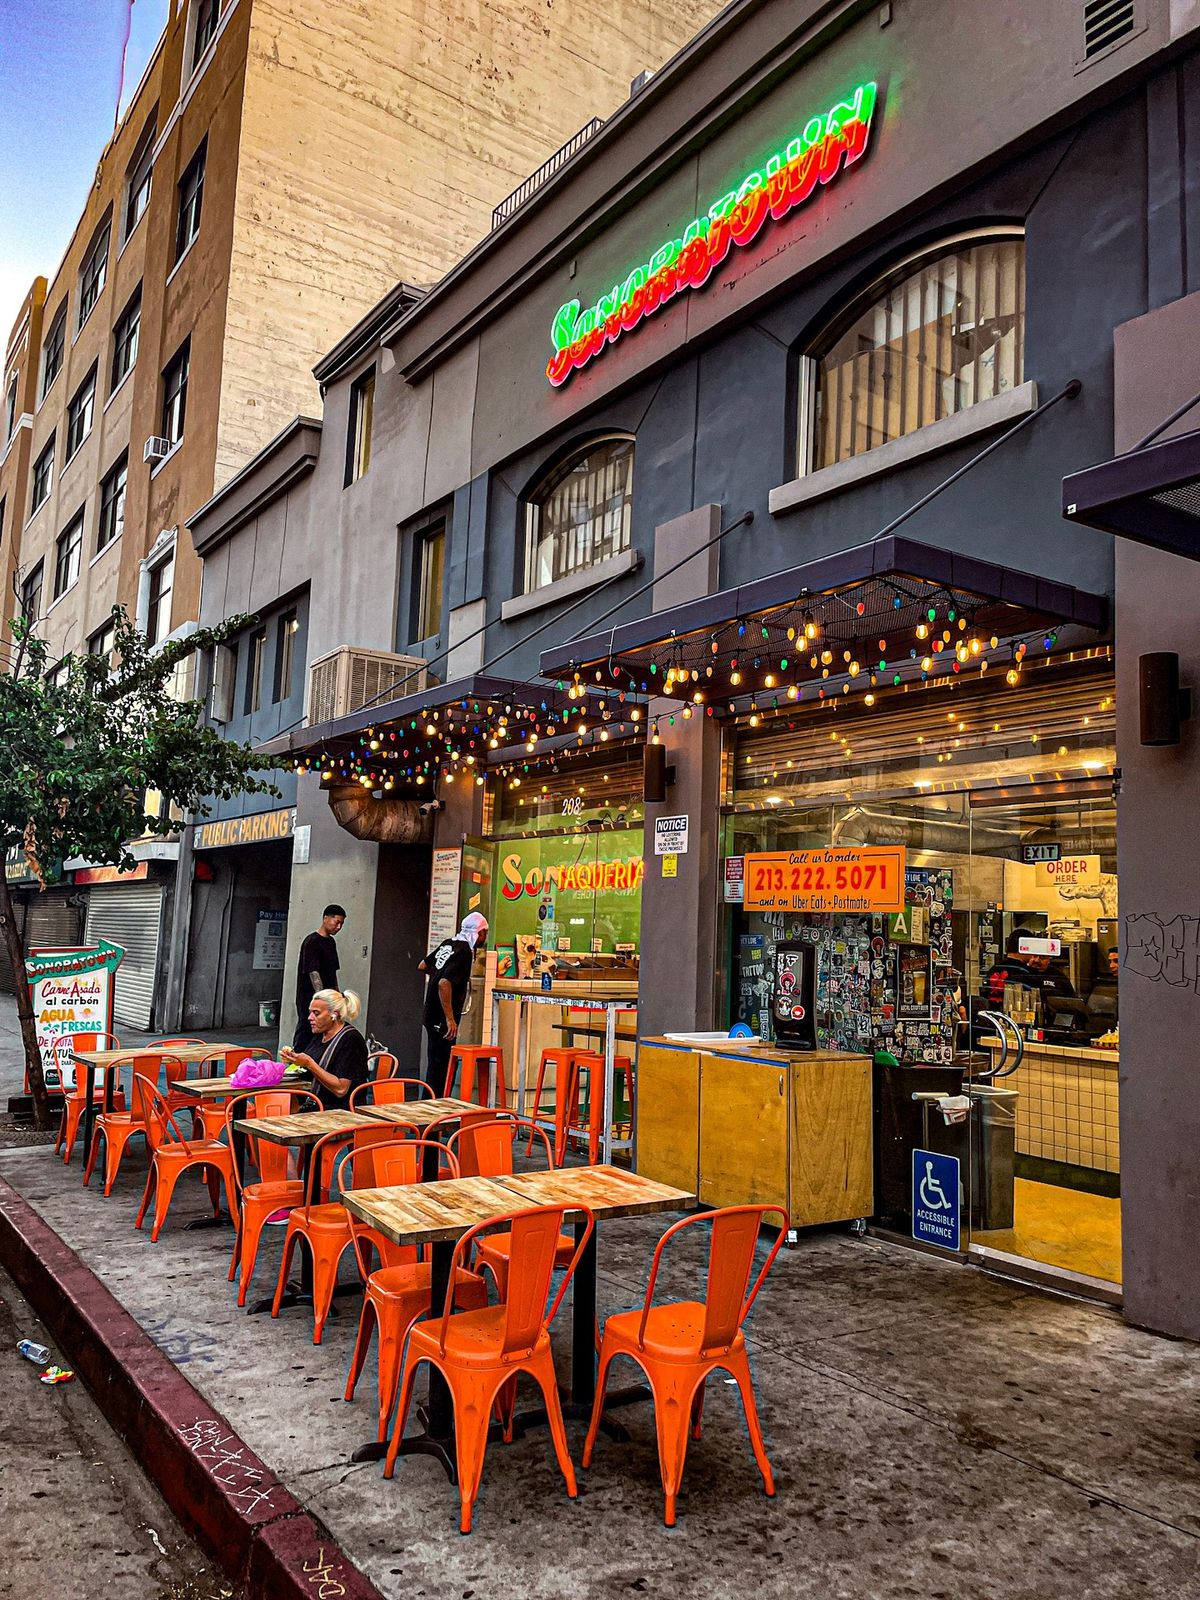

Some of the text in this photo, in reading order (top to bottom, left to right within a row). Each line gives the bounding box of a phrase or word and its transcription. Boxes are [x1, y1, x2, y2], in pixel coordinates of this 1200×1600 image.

[562, 797, 581, 816] 208
[202, 818, 238, 846] PUBLIC
[239, 810, 289, 842] PARKING
[657, 819, 686, 831] NOTICE
[789, 851, 861, 864] Call us to order
[1025, 847, 1054, 859] EXIT
[557, 860, 644, 890] TAQUERIA
[1047, 860, 1087, 874] ORDER
[755, 865, 886, 891] 213.222.5071
[759, 896, 775, 906] and
[778, 898, 788, 906] on
[792, 895, 808, 908] Uber
[810, 895, 827, 909] Eats
[833, 894, 871, 909] Postmates
[259, 911, 273, 919] Pay
[893, 912, 908, 934] A
[42, 982, 101, 998] Carne Asada
[46, 997, 99, 1006] al carbón
[39, 1007, 75, 1024] AGUA
[61, 1021, 102, 1034] FRESCAS
[917, 1209, 955, 1227] ACCESSIBLE
[920, 1221, 952, 1239] ENTRANCE
